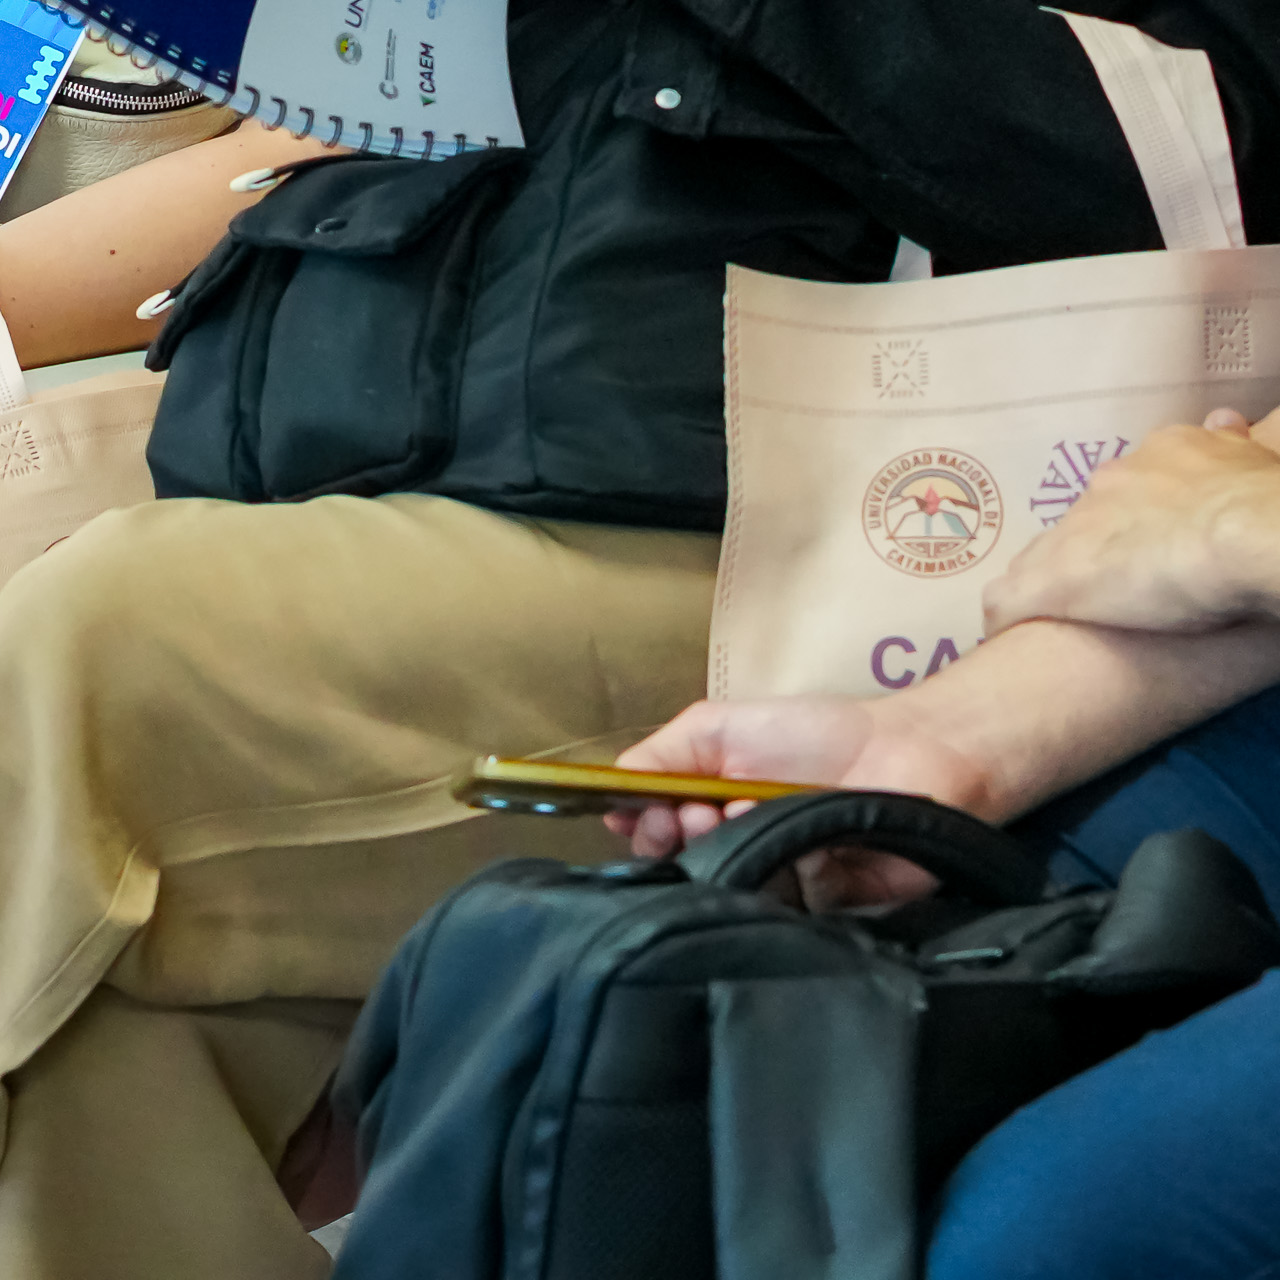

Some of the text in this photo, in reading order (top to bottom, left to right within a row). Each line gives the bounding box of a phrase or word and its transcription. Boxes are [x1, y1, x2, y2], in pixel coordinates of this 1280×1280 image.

[420, 41, 436, 94] CAEM
[869, 453, 932, 529] UNIVERSIDAD
[938, 454, 995, 507] NACIONAL
[983, 510, 998, 529] DE
[886, 548, 976, 573] CATAMARCA
